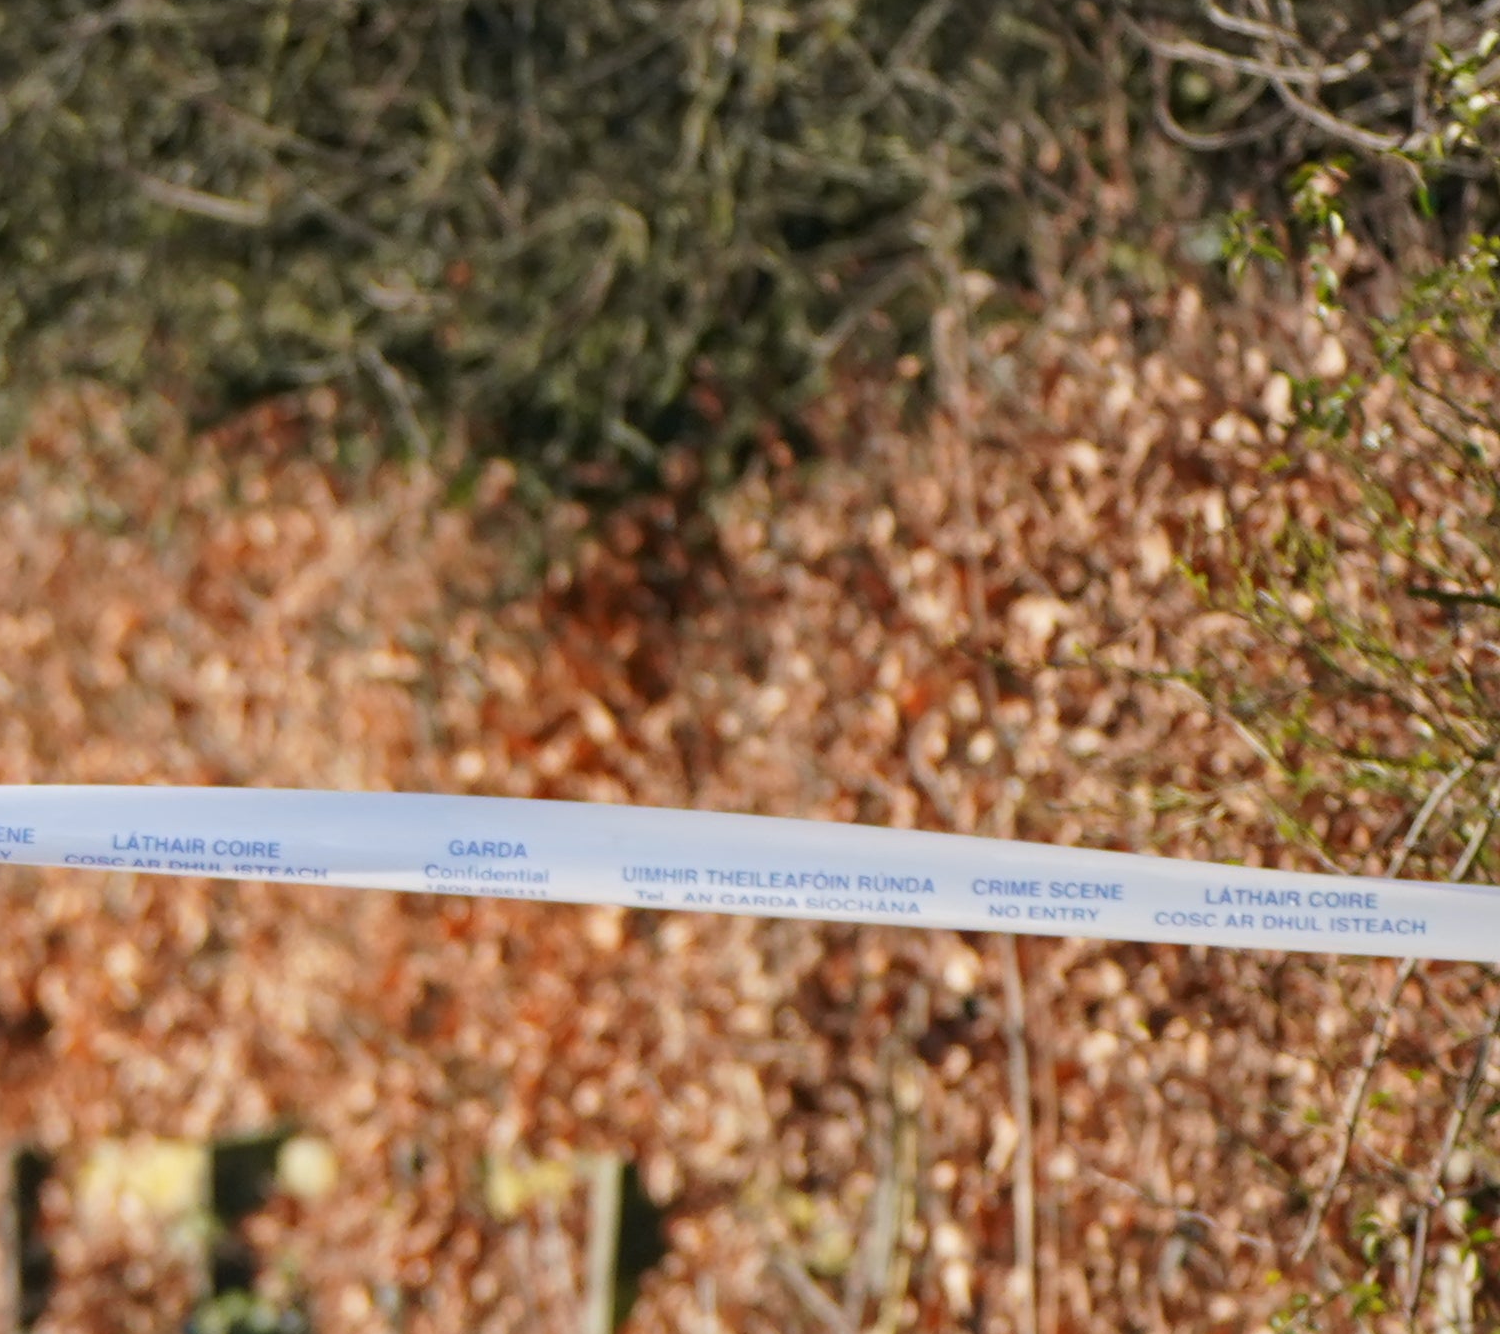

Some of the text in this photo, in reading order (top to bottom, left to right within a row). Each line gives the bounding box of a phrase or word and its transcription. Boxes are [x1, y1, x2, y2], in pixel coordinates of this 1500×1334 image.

[213, 840, 281, 858] COIRE
[449, 839, 527, 858] GARDA
[425, 864, 549, 883] Confidential
[623, 866, 698, 884] UIMHIR
[972, 879, 1124, 900] CRIME SCENE
[1205, 885, 1379, 909] LÁTHAIR COIRE
[684, 892, 712, 903] AN
[720, 893, 798, 908] GARDA
[988, 905, 1099, 921] NO ENTRY
[1155, 911, 1426, 935] COSC AR DHUL ISTEACH
